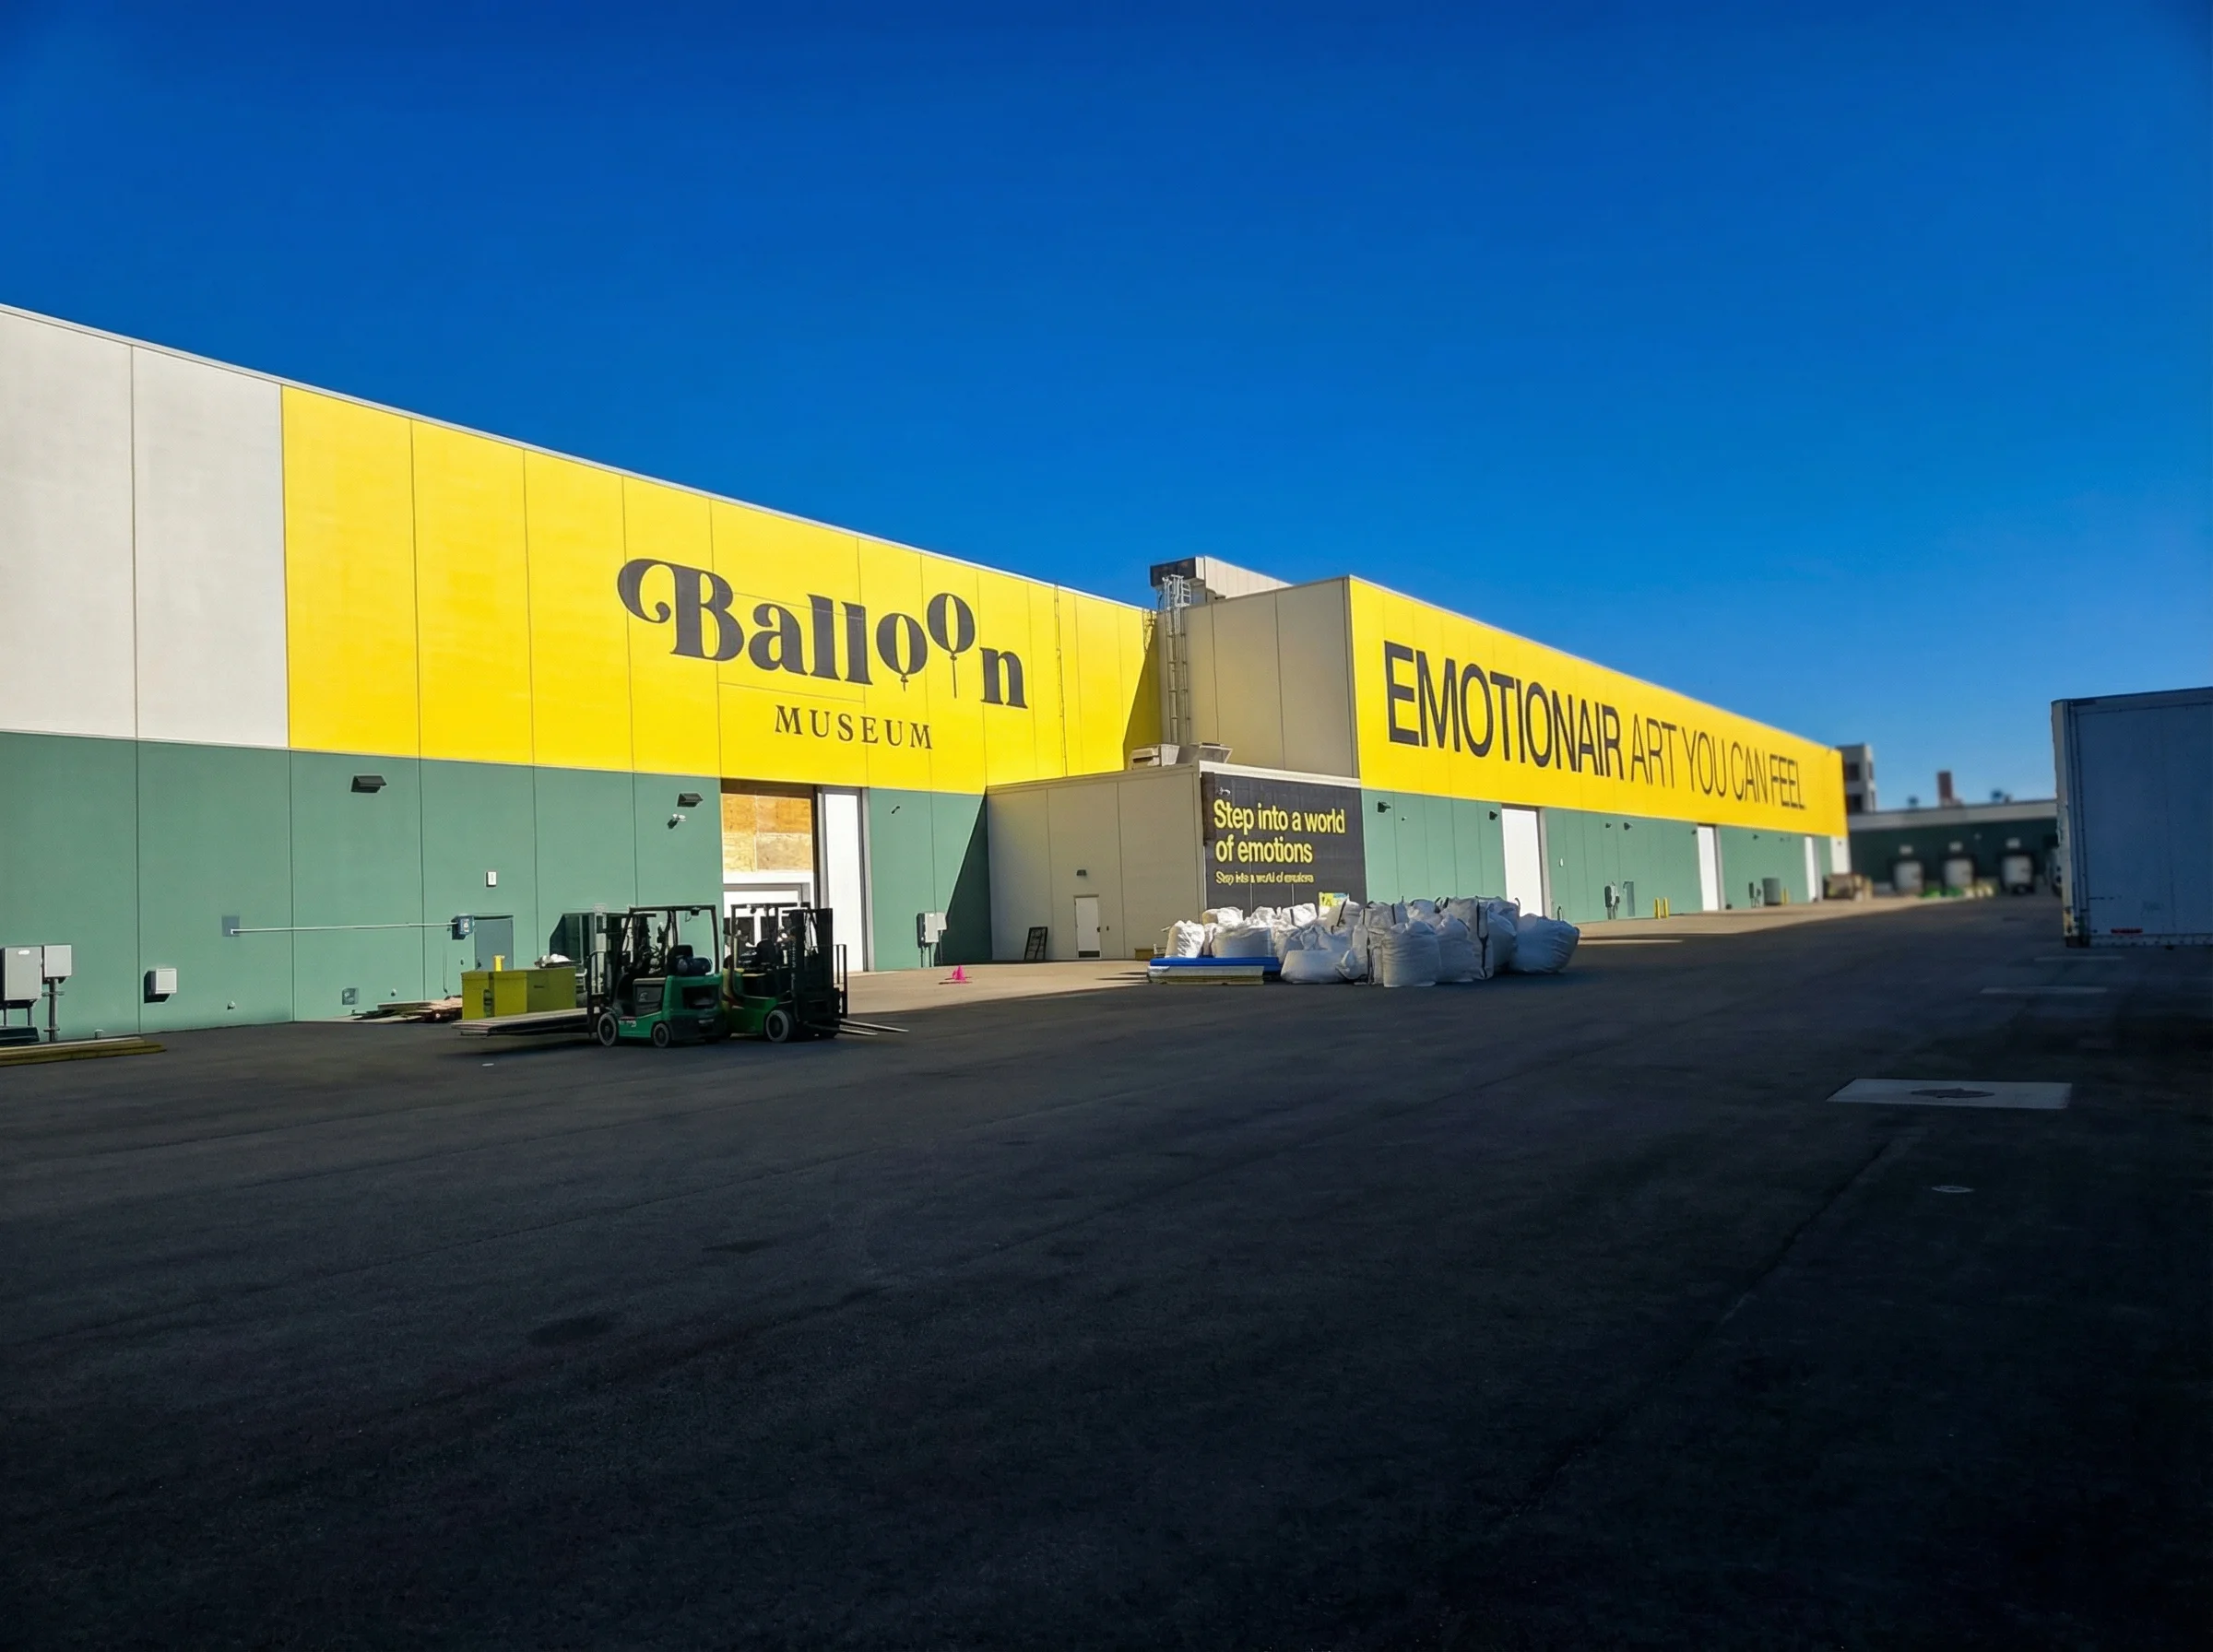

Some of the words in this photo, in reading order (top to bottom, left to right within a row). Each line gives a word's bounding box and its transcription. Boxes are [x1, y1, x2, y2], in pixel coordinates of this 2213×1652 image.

[617, 558, 1028, 709] Balloon
[775, 704, 933, 749] MUSEUM
[1383, 640, 1625, 782] EMOTIONAIR
[1630, 713, 1677, 789] ART
[1682, 726, 1728, 798] YOU
[1730, 740, 1769, 805] CAN
[1769, 753, 1806, 811] FEEL
[1213, 798, 1255, 836] Step
[1257, 802, 1289, 832] into
[1292, 810, 1302, 832] a
[1304, 808, 1346, 833] world
[1215, 833, 1235, 863] of
[1237, 835, 1314, 864] emotions
